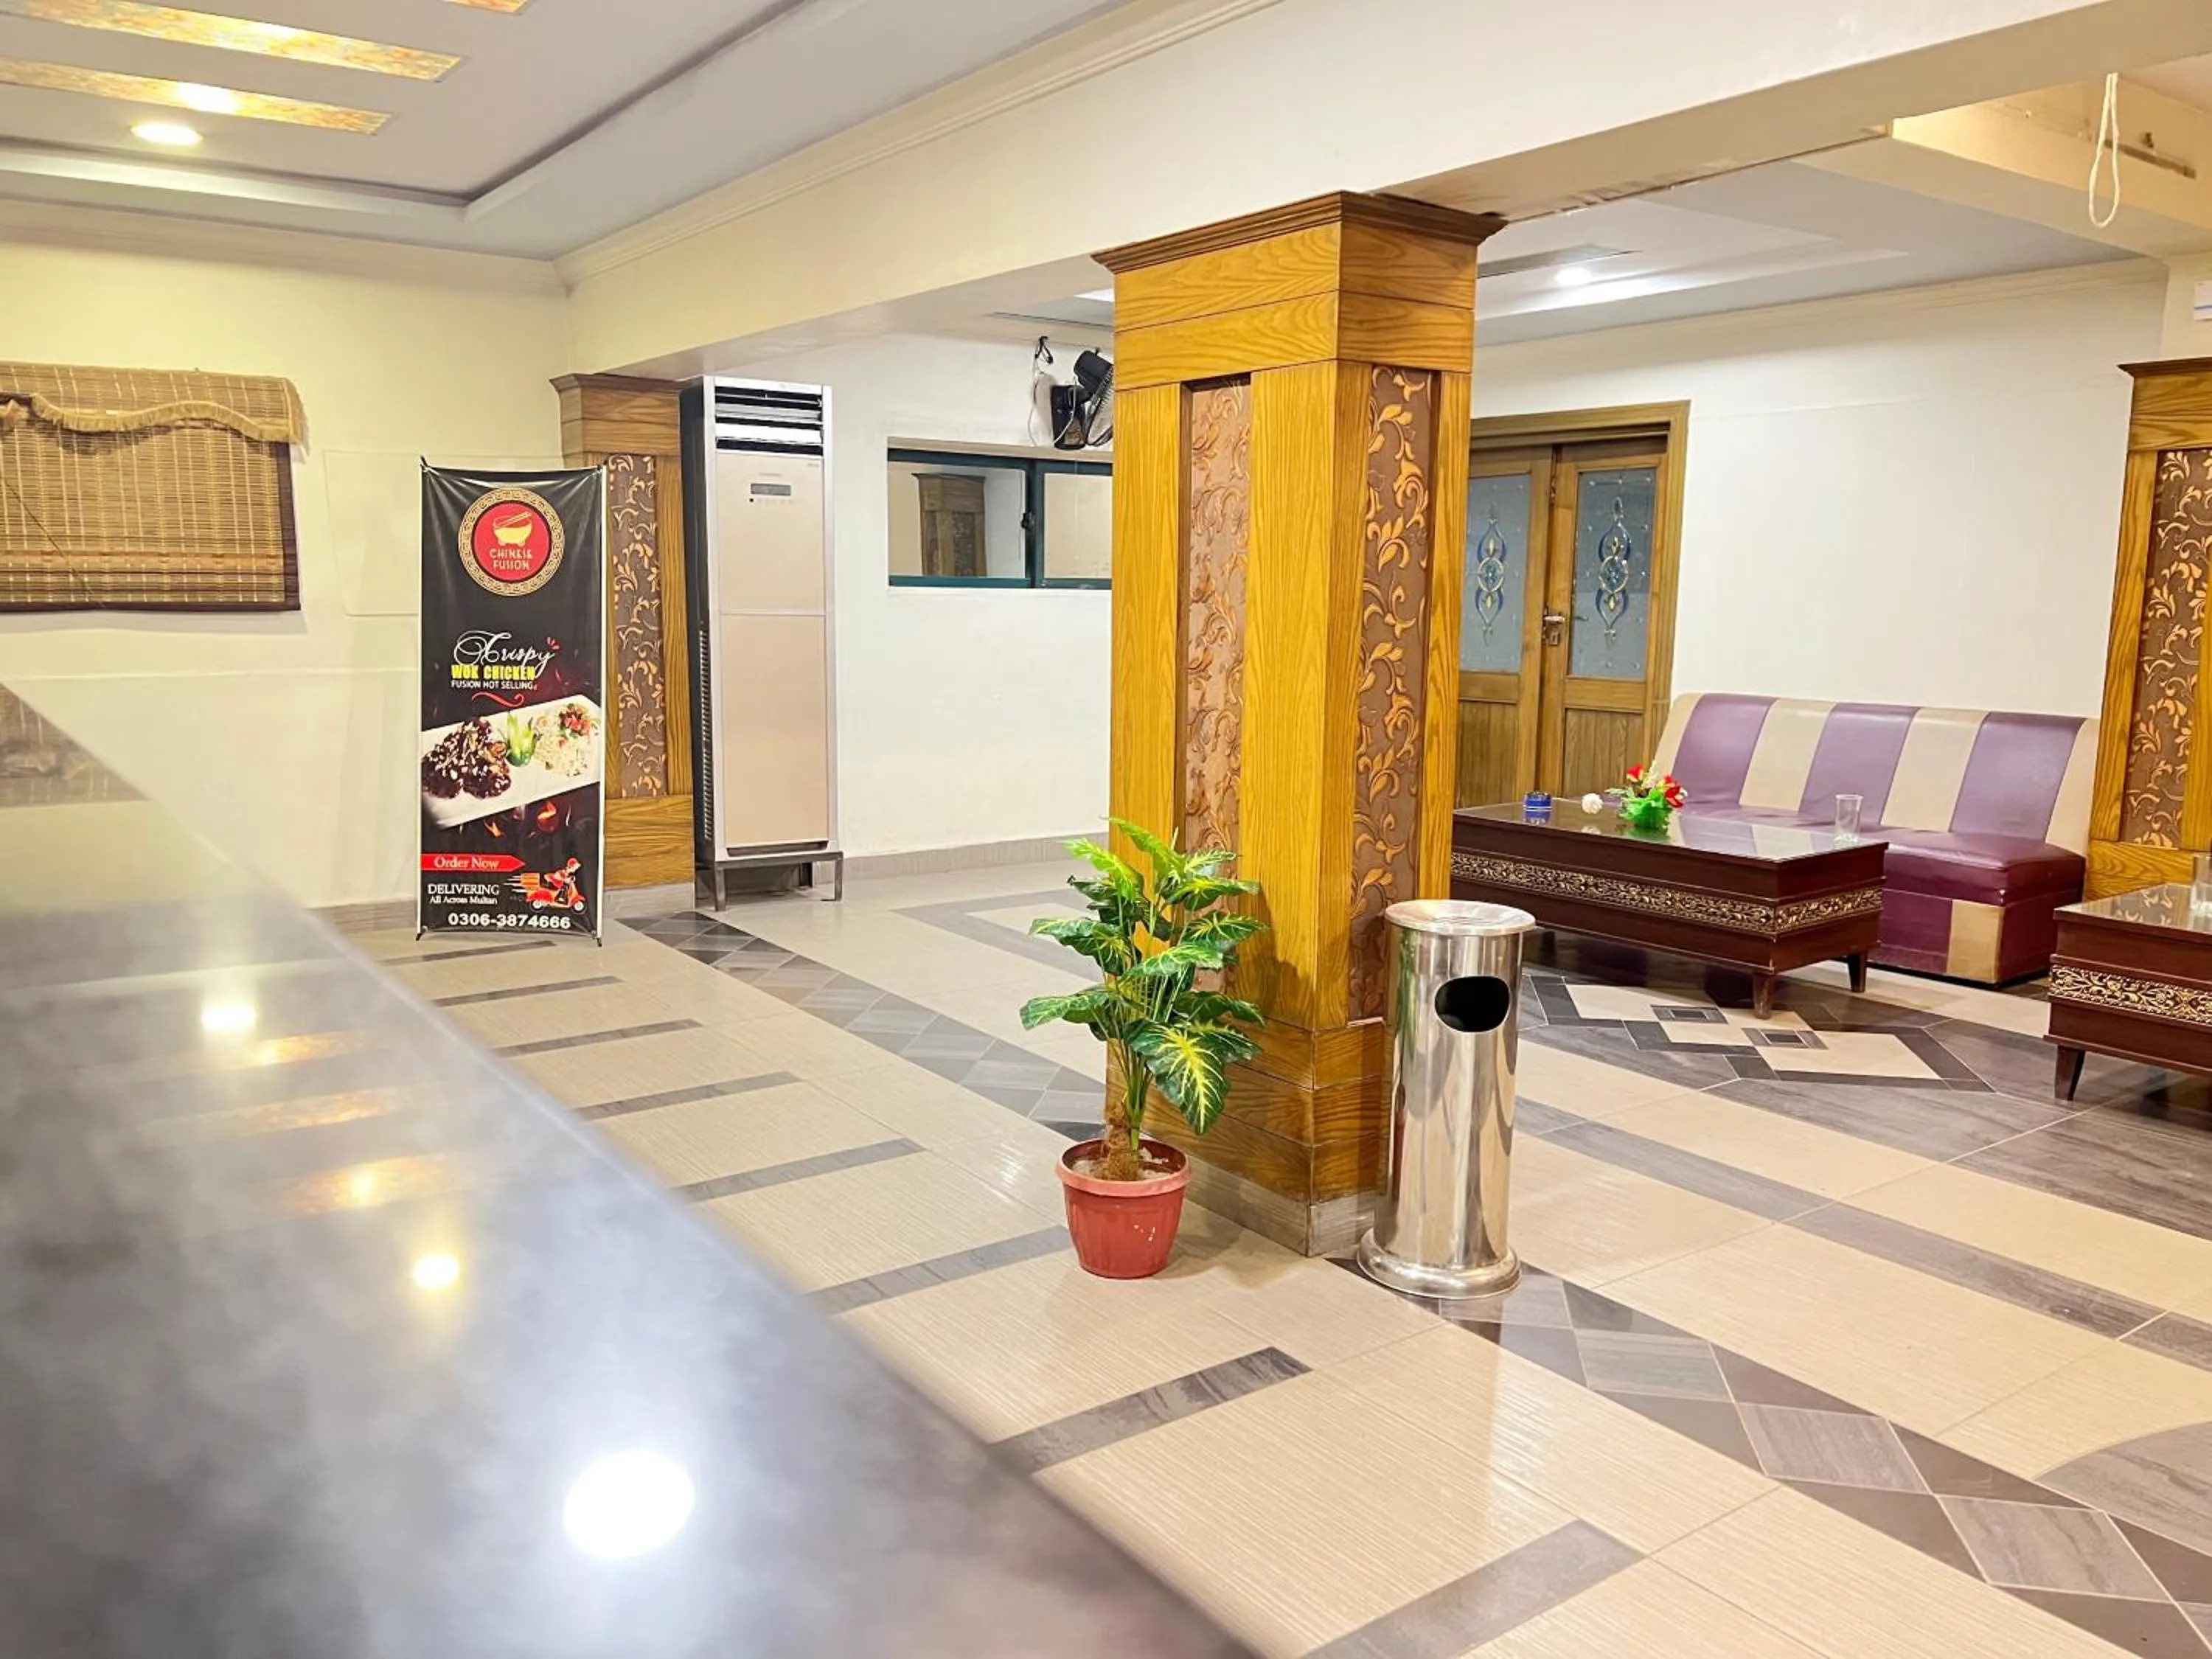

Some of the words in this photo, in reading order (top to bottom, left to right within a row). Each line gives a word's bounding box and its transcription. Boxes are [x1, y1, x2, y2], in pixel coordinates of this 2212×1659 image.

[451, 664, 479, 679] WOK
[483, 664, 536, 681] CHICKEN
[451, 679, 481, 688] FUSION
[483, 680, 499, 689] HOT
[434, 855, 470, 869] Order
[471, 855, 500, 869] Now
[428, 883, 500, 896] DELIVERING
[430, 895, 442, 905] All
[443, 895, 468, 904] Across
[469, 895, 498, 905] Multan
[448, 912, 571, 929] 0306-3874666
